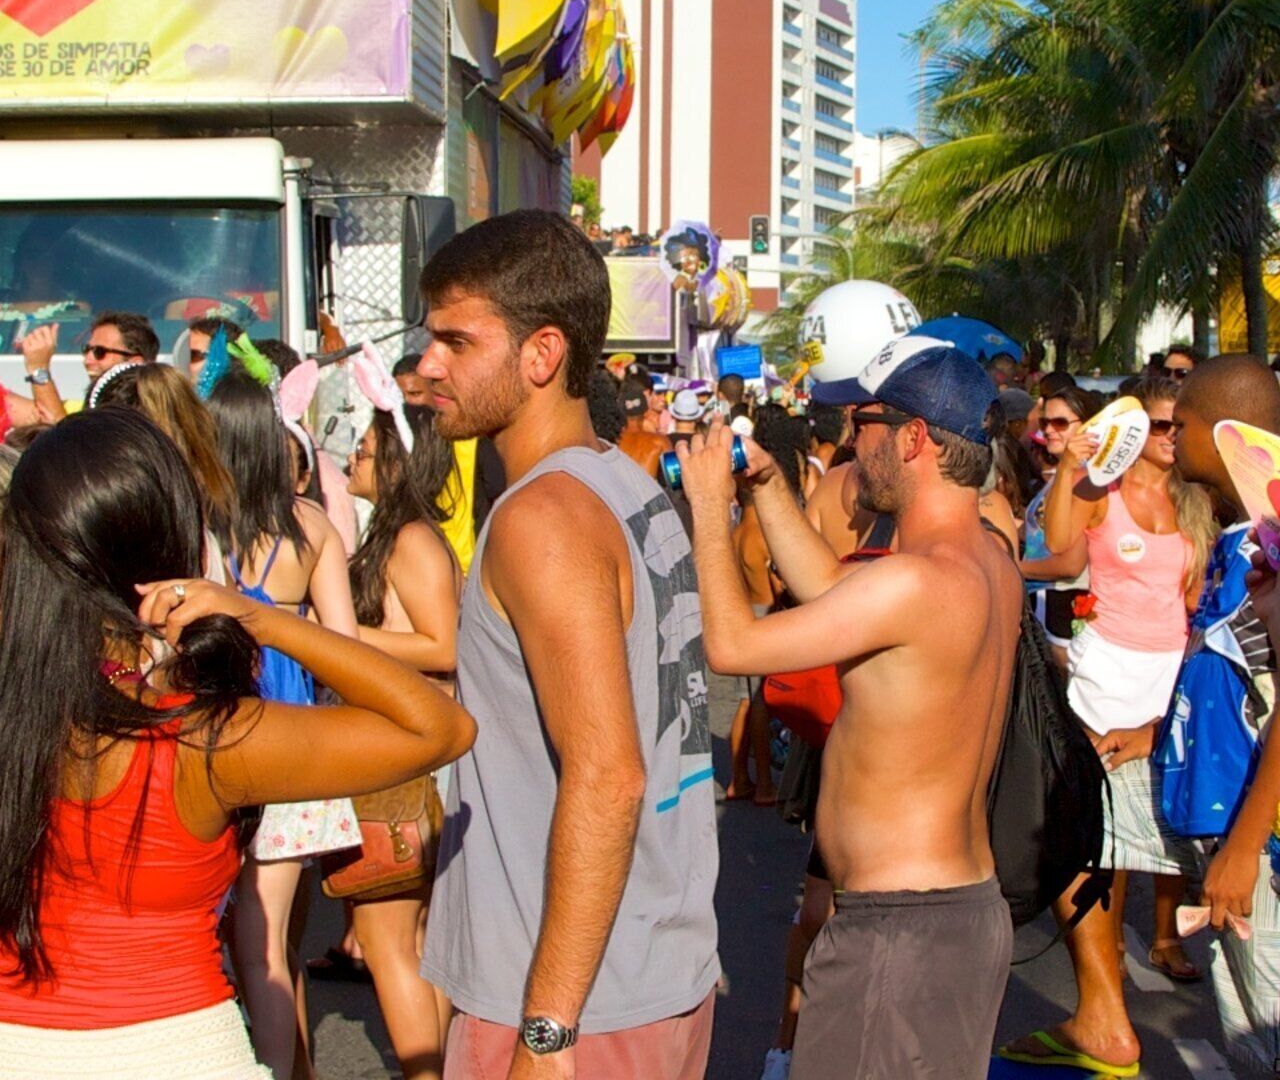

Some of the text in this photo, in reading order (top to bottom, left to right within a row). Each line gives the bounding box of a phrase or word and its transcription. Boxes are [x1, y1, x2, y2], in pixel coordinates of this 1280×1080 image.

[23, 42, 49, 60] DE
[57, 41, 153, 60] SIMPATIA
[22, 60, 44, 78] 30
[49, 59, 76, 77] DE
[84, 58, 151, 77] AMOR
